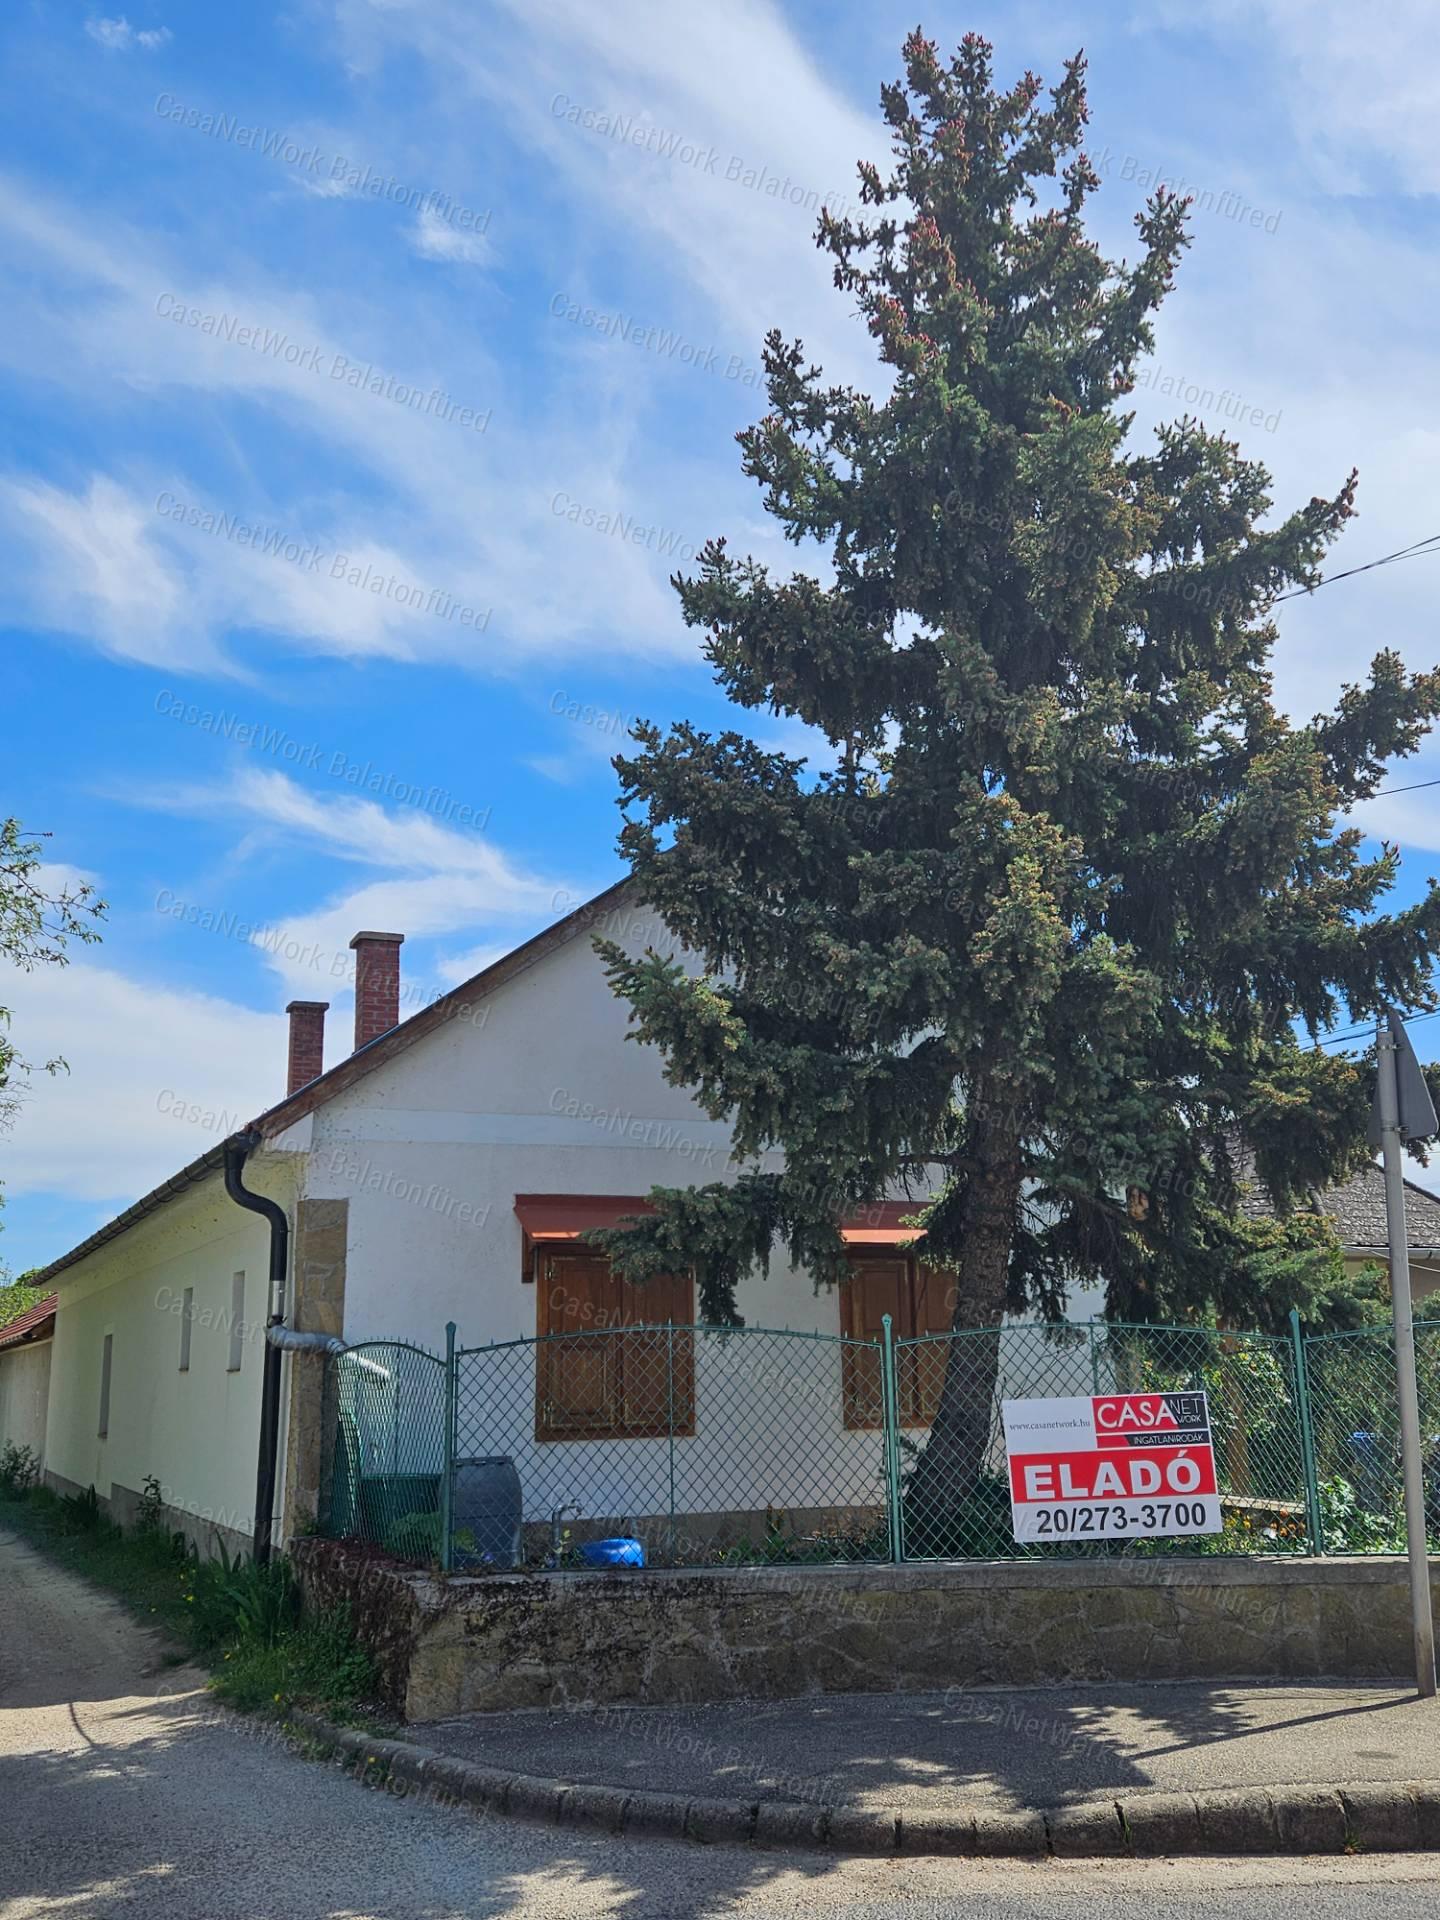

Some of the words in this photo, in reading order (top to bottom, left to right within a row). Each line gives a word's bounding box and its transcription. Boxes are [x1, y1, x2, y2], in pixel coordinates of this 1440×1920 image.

[1009, 1418, 1091, 1431] www.casanetwork.hu
[1097, 1399, 1178, 1428] CASA
[1169, 1398, 1200, 1415] NET
[1176, 1414, 1201, 1424] WORK
[1023, 1449, 1201, 1500] ELADÓ
[1037, 1502, 1206, 1534] 20/273-3700
